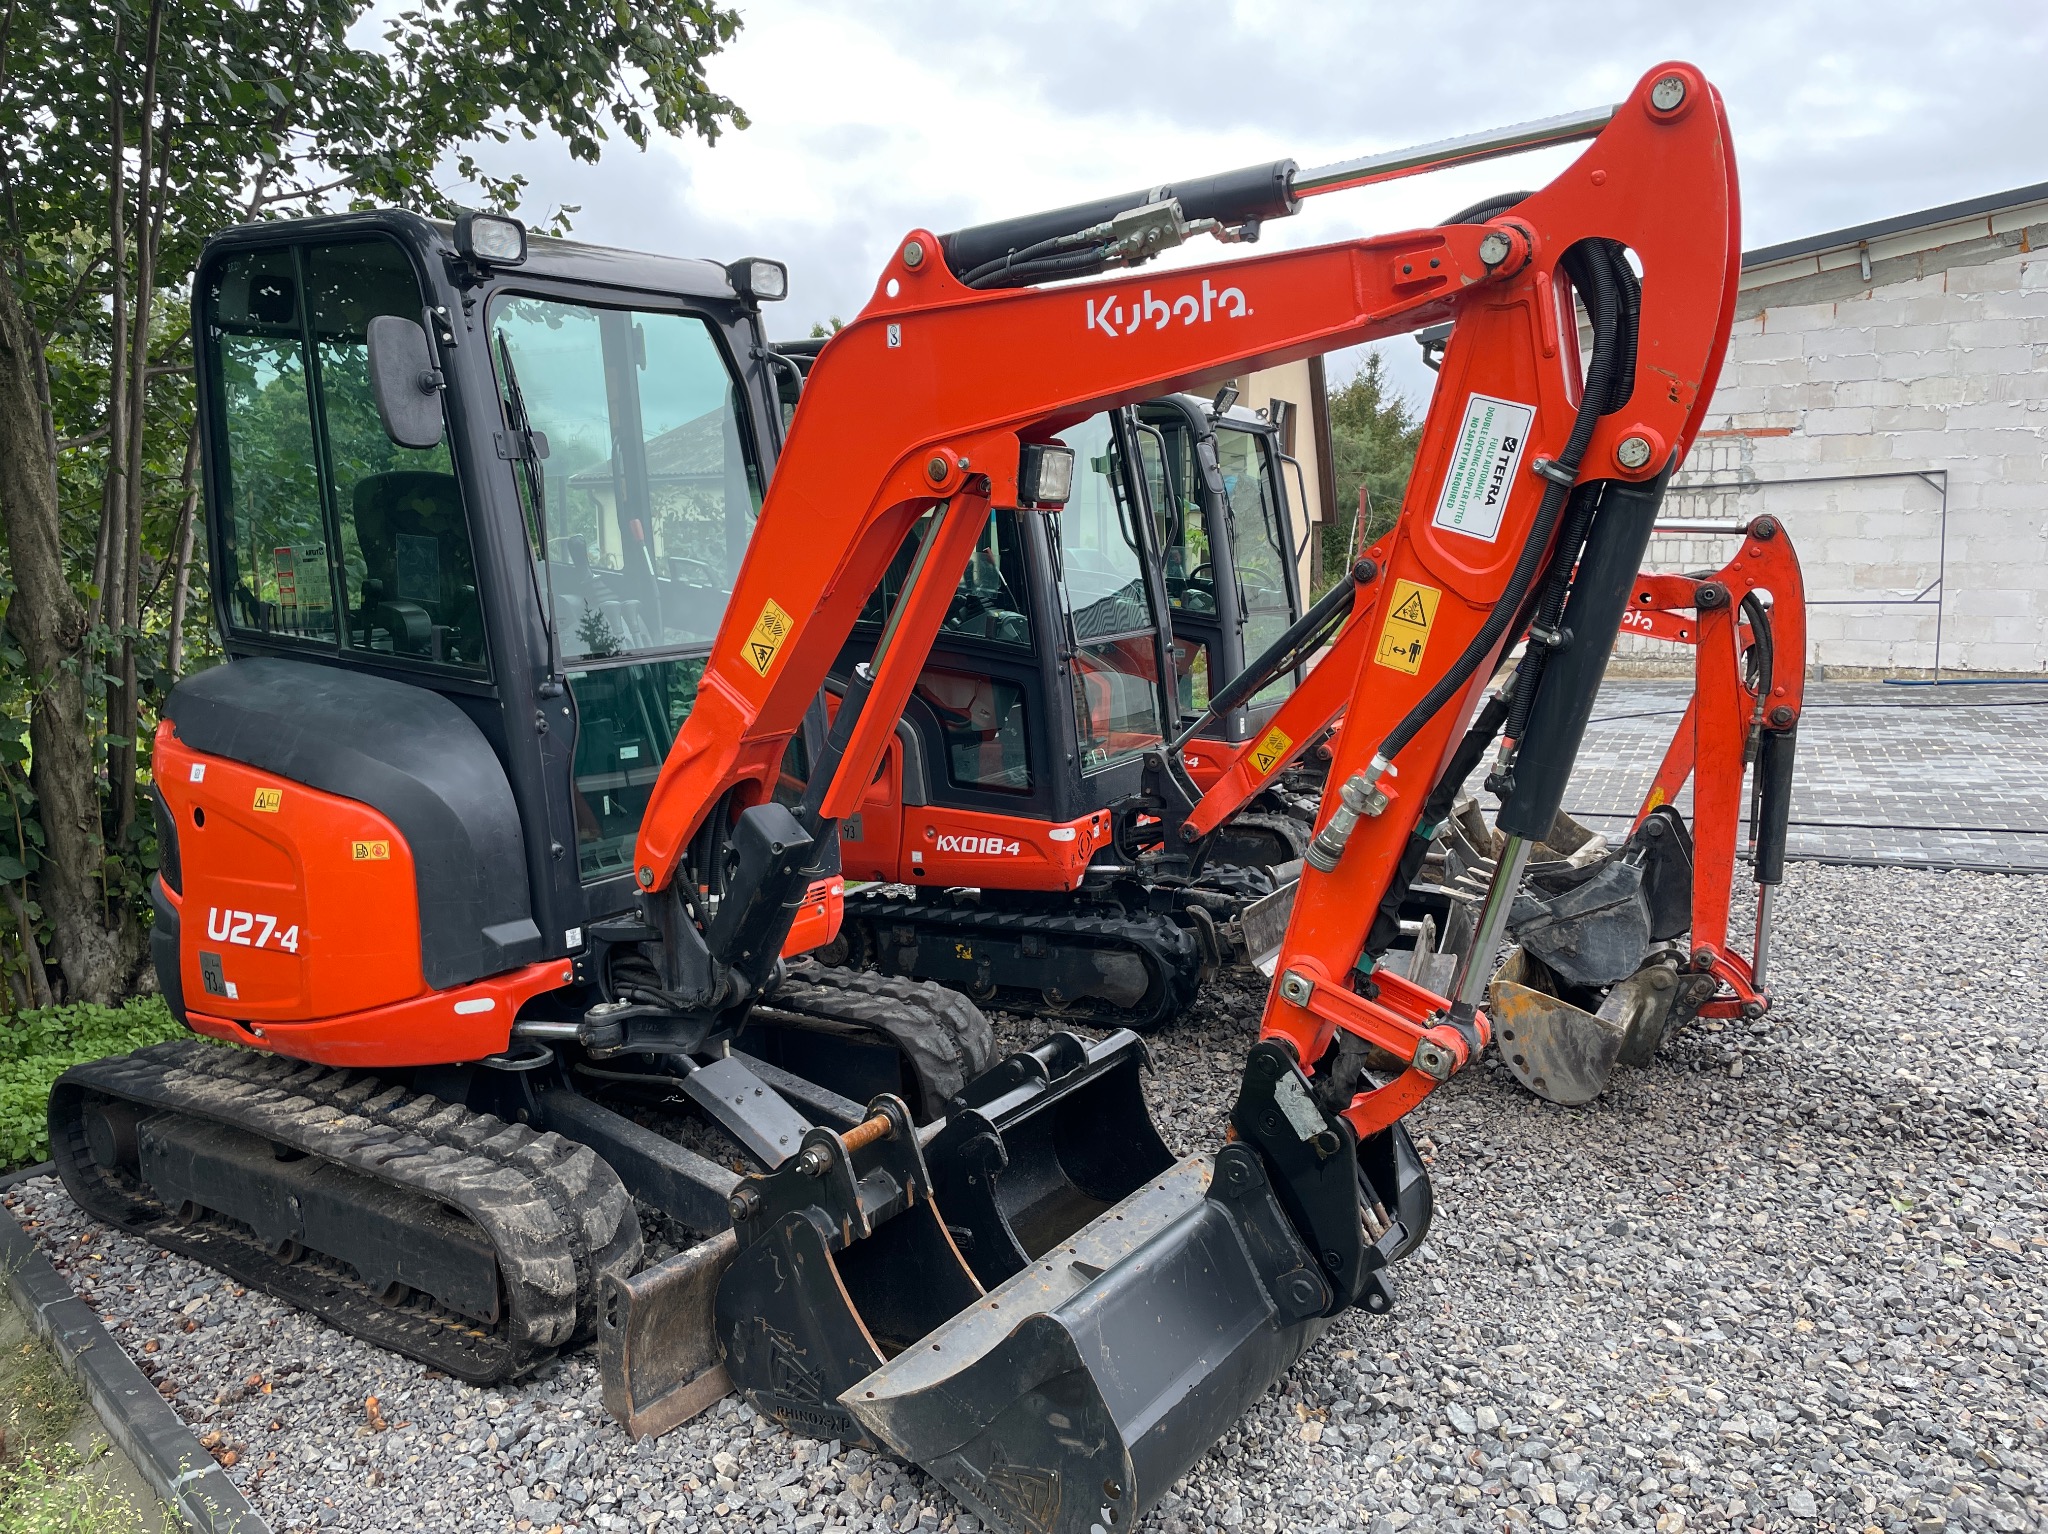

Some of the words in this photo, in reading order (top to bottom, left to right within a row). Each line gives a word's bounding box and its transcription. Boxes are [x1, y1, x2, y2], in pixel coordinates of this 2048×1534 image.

[1086, 279, 1247, 337] Kubota
[1471, 417, 1479, 428] NO
[1481, 407, 1495, 435] DOUBLE
[1463, 430, 1475, 456] SAFETY
[1471, 437, 1486, 466] LOCKING
[1487, 438, 1498, 459] FULLY
[1458, 457, 1467, 470] PIN
[1447, 472, 1463, 508] REQUIRED
[1461, 468, 1476, 499] COUPLER
[1474, 459, 1491, 500] AUTOMATIC
[1485, 456, 1510, 505] TEFRA
[1454, 501, 1466, 524] FITTED
[1622, 610, 1653, 631] ota
[843, 825, 855, 839] 93
[936, 835, 1020, 856] KX018-4
[207, 907, 299, 953] U27-4
[205, 970, 217, 992] 93
